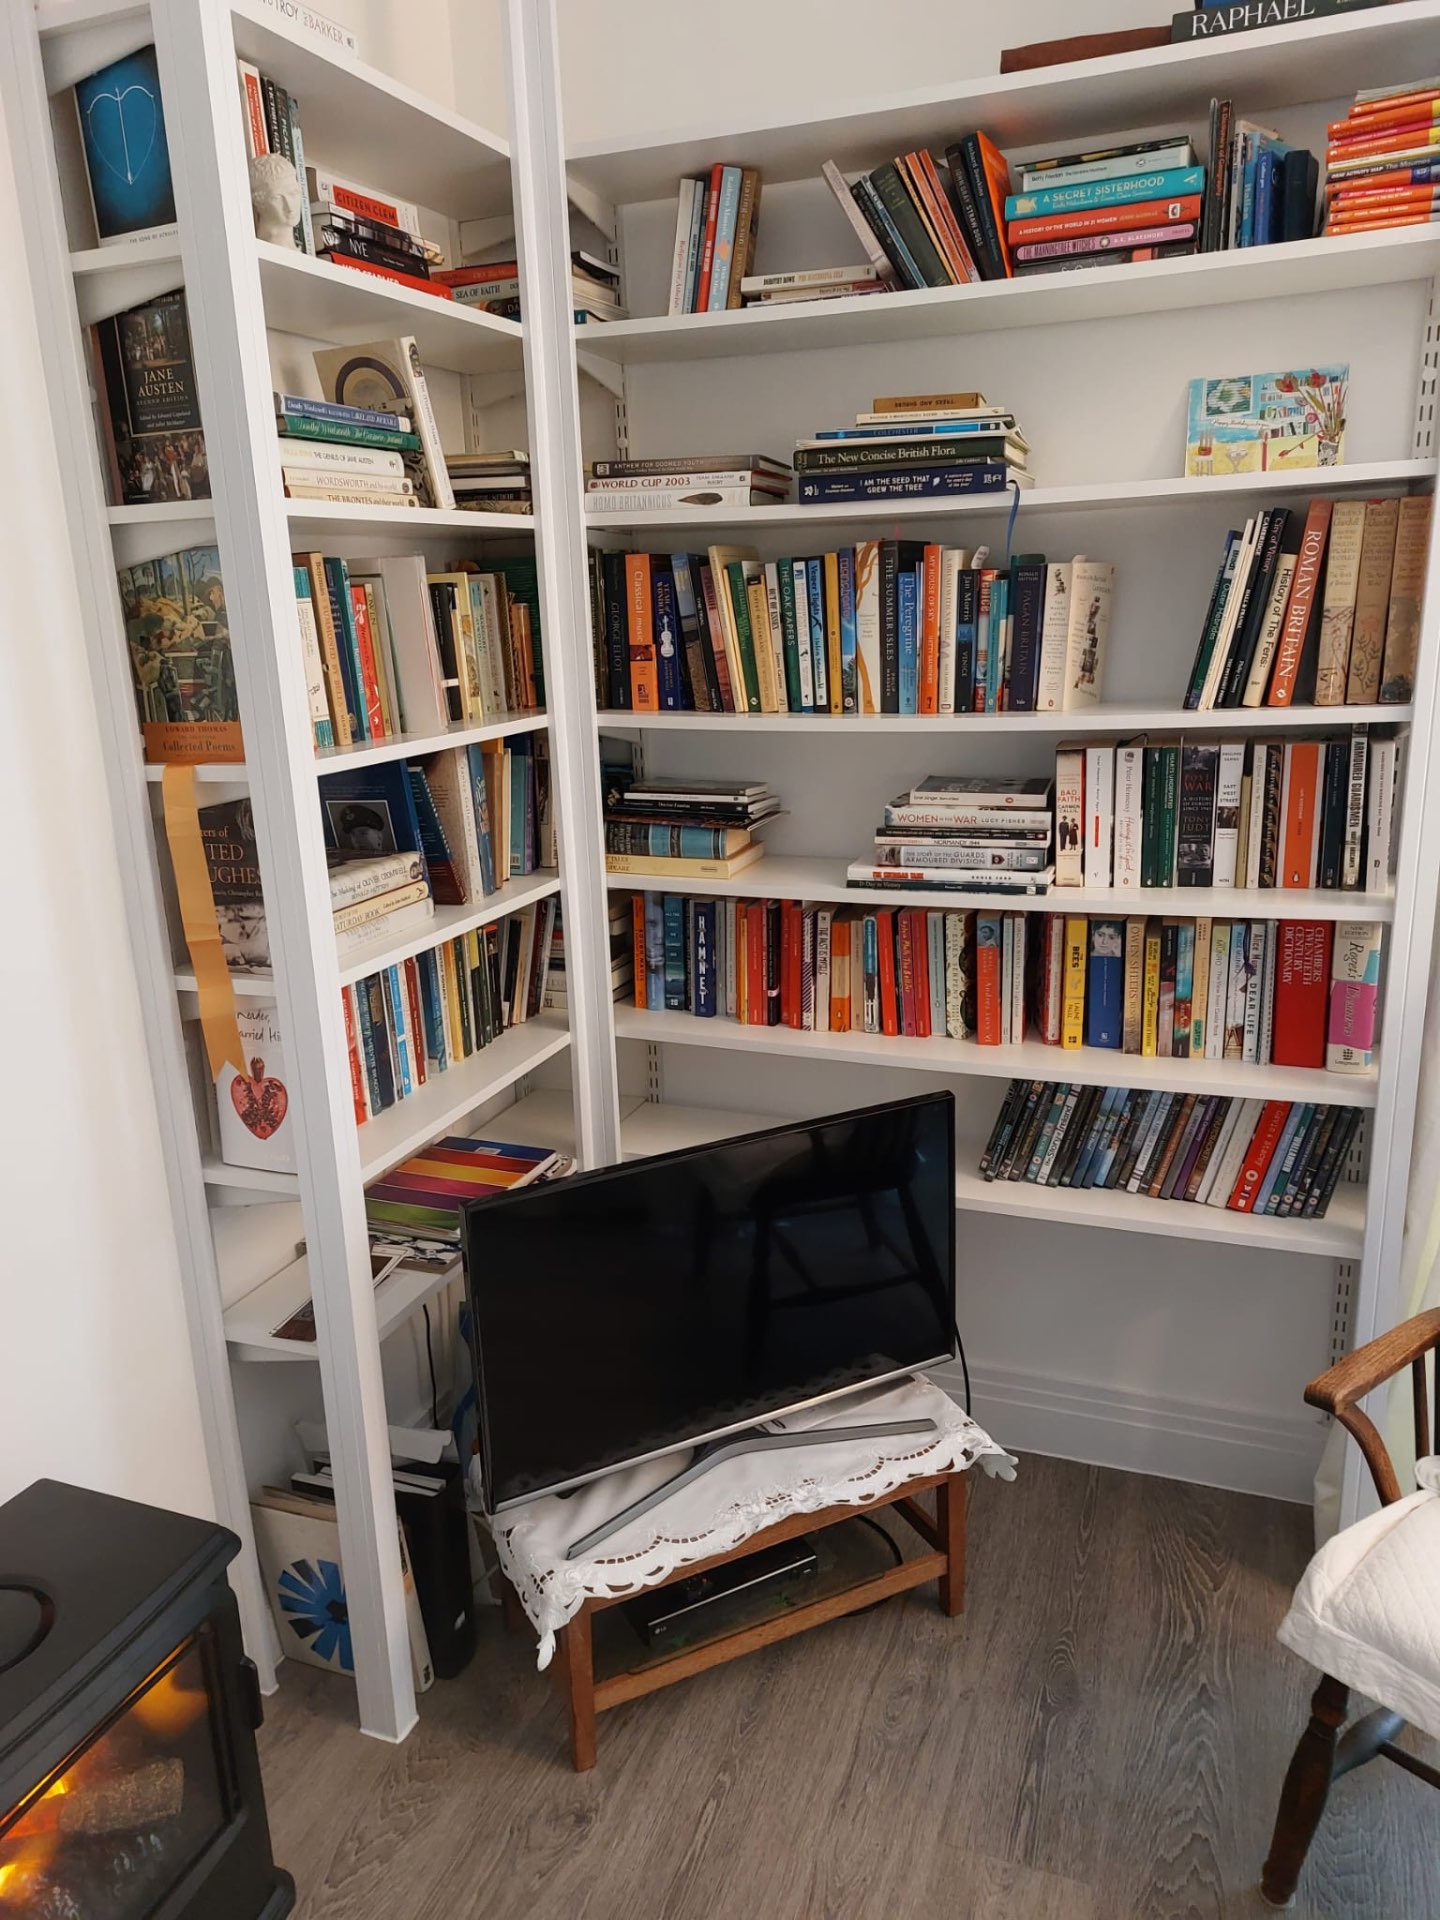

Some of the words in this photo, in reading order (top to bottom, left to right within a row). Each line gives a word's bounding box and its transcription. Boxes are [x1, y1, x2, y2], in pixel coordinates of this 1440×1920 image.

[1191, 0, 1316, 36] RAPHAEL
[1043, 195, 1049, 203] A
[1052, 186, 1092, 202] SECRET
[1095, 175, 1165, 196] SISTERHOOD
[335, 191, 372, 214] CITIZEN
[373, 206, 396, 222] CLEM
[965, 204, 979, 228] STRAW
[972, 228, 984, 247] DOGS
[1023, 226, 1045, 235] HISTORY
[1064, 221, 1083, 230] WORLD
[350, 239, 368, 258] NYE
[455, 290, 468, 300] SEA
[469, 288, 478, 297] OF
[143, 367, 175, 384] JANE
[138, 381, 185, 398] AUSTEN
[313, 451, 322, 459] THE
[613, 461, 639, 469] ANTHEM
[655, 460, 681, 468] DOOMED
[817, 454, 836, 465] The
[837, 452, 858, 464] New
[860, 449, 897, 461] Concise
[898, 447, 930, 459] British
[931, 445, 956, 456] Flora
[316, 475, 369, 489] WORDSWORTH
[601, 478, 638, 489] WORLD
[641, 478, 662, 487] CUP
[665, 476, 691, 486] 2003
[863, 478, 876, 486] AM
[877, 477, 890, 485] THE
[892, 476, 911, 484] SEED
[913, 475, 930, 483] THAT
[867, 485, 887, 494] GREW
[905, 483, 923, 491] TREE
[327, 494, 341, 503] THE
[619, 493, 672, 511] BRITANNICUS
[1255, 516, 1270, 557] CAMBRIDGE
[1271, 517, 1284, 534] City
[1270, 535, 1279, 545] of
[885, 557, 894, 580] THE
[929, 555, 935, 568] MY
[1262, 545, 1277, 574] Victory
[1295, 530, 1322, 599] ROMAN
[780, 566, 790, 584] THE
[810, 564, 819, 592] Vesper
[963, 575, 972, 589] Jan
[1275, 568, 1292, 604] History
[633, 570, 644, 614] Classical
[768, 588, 777, 601] OUT
[782, 586, 791, 609] OAK
[904, 575, 915, 598] The
[1219, 583, 1232, 605] Outer
[769, 601, 778, 611] OF
[811, 592, 820, 616] Flights
[886, 582, 895, 630] SUMMER
[928, 596, 935, 606] OF
[963, 592, 972, 622] Morris
[1020, 589, 1033, 627] PAGAN
[1272, 606, 1283, 616] of
[610, 602, 623, 642] GEORGE
[636, 617, 644, 642] music
[770, 611, 779, 631] ESSEX
[785, 611, 795, 646] PAPERS
[902, 602, 915, 655] Peregrine
[1209, 606, 1226, 641] Hebrides
[1266, 620, 1279, 639] The
[322, 605, 337, 660] SUMMONED
[331, 664, 339, 675] BY
[886, 633, 895, 661] ISLES
[1278, 604, 1307, 678] BRITAIN
[612, 644, 623, 673] ELIOT
[1018, 630, 1031, 676] BRITAIN
[1259, 640, 1272, 669] Fens:
[163, 741, 203, 752] Collected
[205, 739, 236, 751] Poems
[1352, 741, 1365, 781] ARMOURED
[1125, 765, 1134, 782] Peter
[1184, 781, 1212, 791] WAR
[1123, 783, 1134, 813] Hennessy
[1349, 782, 1362, 828] GUARDSMEN
[897, 813, 939, 823] WOMEN
[953, 815, 978, 825] WAR
[1183, 823, 1209, 832] JUDT
[218, 826, 229, 838] of
[205, 843, 244, 861] TED
[950, 857, 986, 865] DIVISION
[338, 886, 356, 896] Making
[362, 875, 380, 887] OLIVER
[364, 908, 380, 920] BOOK
[819, 927, 829, 937] THE
[1130, 926, 1140, 959] OWEN
[1252, 932, 1263, 950] Alice
[819, 937, 828, 951] PAST
[1214, 939, 1224, 966] MUNRO
[1293, 926, 1305, 973] CENTURY
[1313, 927, 1325, 983] CHAMBERS
[697, 915, 709, 1005] HAMNET
[818, 956, 828, 976] MYSELF
[903, 958, 912, 969] The
[1072, 946, 1080, 968] BEES
[1282, 926, 1295, 985] DICTIONARY
[1302, 927, 1315, 985] TWENTIETH
[1343, 941, 1365, 980] Roget's
[903, 970, 912, 984] Bell
[1128, 960, 1140, 1000] SHEERS
[904, 984, 912, 993] Jar
[1247, 983, 1258, 1010] DEAR
[238, 1028, 265, 1041] arried
[1246, 1013, 1256, 1036] LIFE
[1044, 1135, 1061, 1158] Story
[1057, 1104, 1073, 1130] Ireland
[1281, 1136, 1304, 1173] WALLANDER
